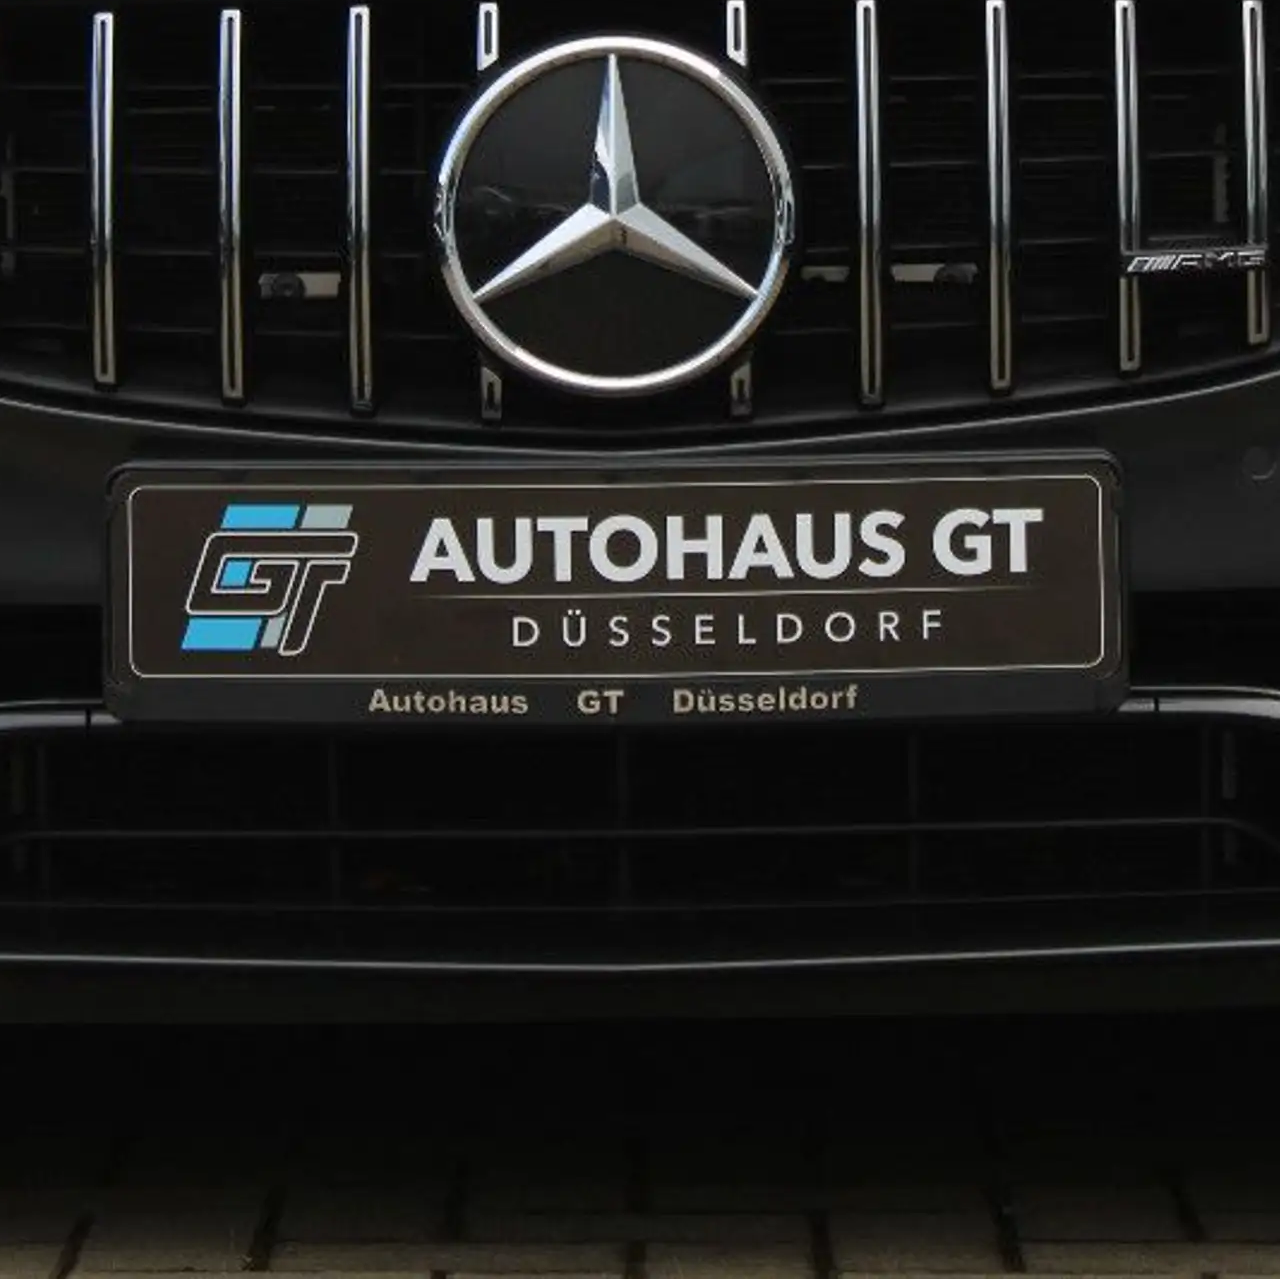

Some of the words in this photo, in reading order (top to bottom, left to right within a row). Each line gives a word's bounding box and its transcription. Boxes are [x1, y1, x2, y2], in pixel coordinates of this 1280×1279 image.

[409, 510, 907, 584] AUTOHAUS
[932, 507, 1045, 577] GT
[511, 609, 942, 648] DÜSSELDORF
[368, 687, 529, 715] Autohaus
[577, 689, 625, 715] GT
[672, 684, 860, 715] Düsseldorf
